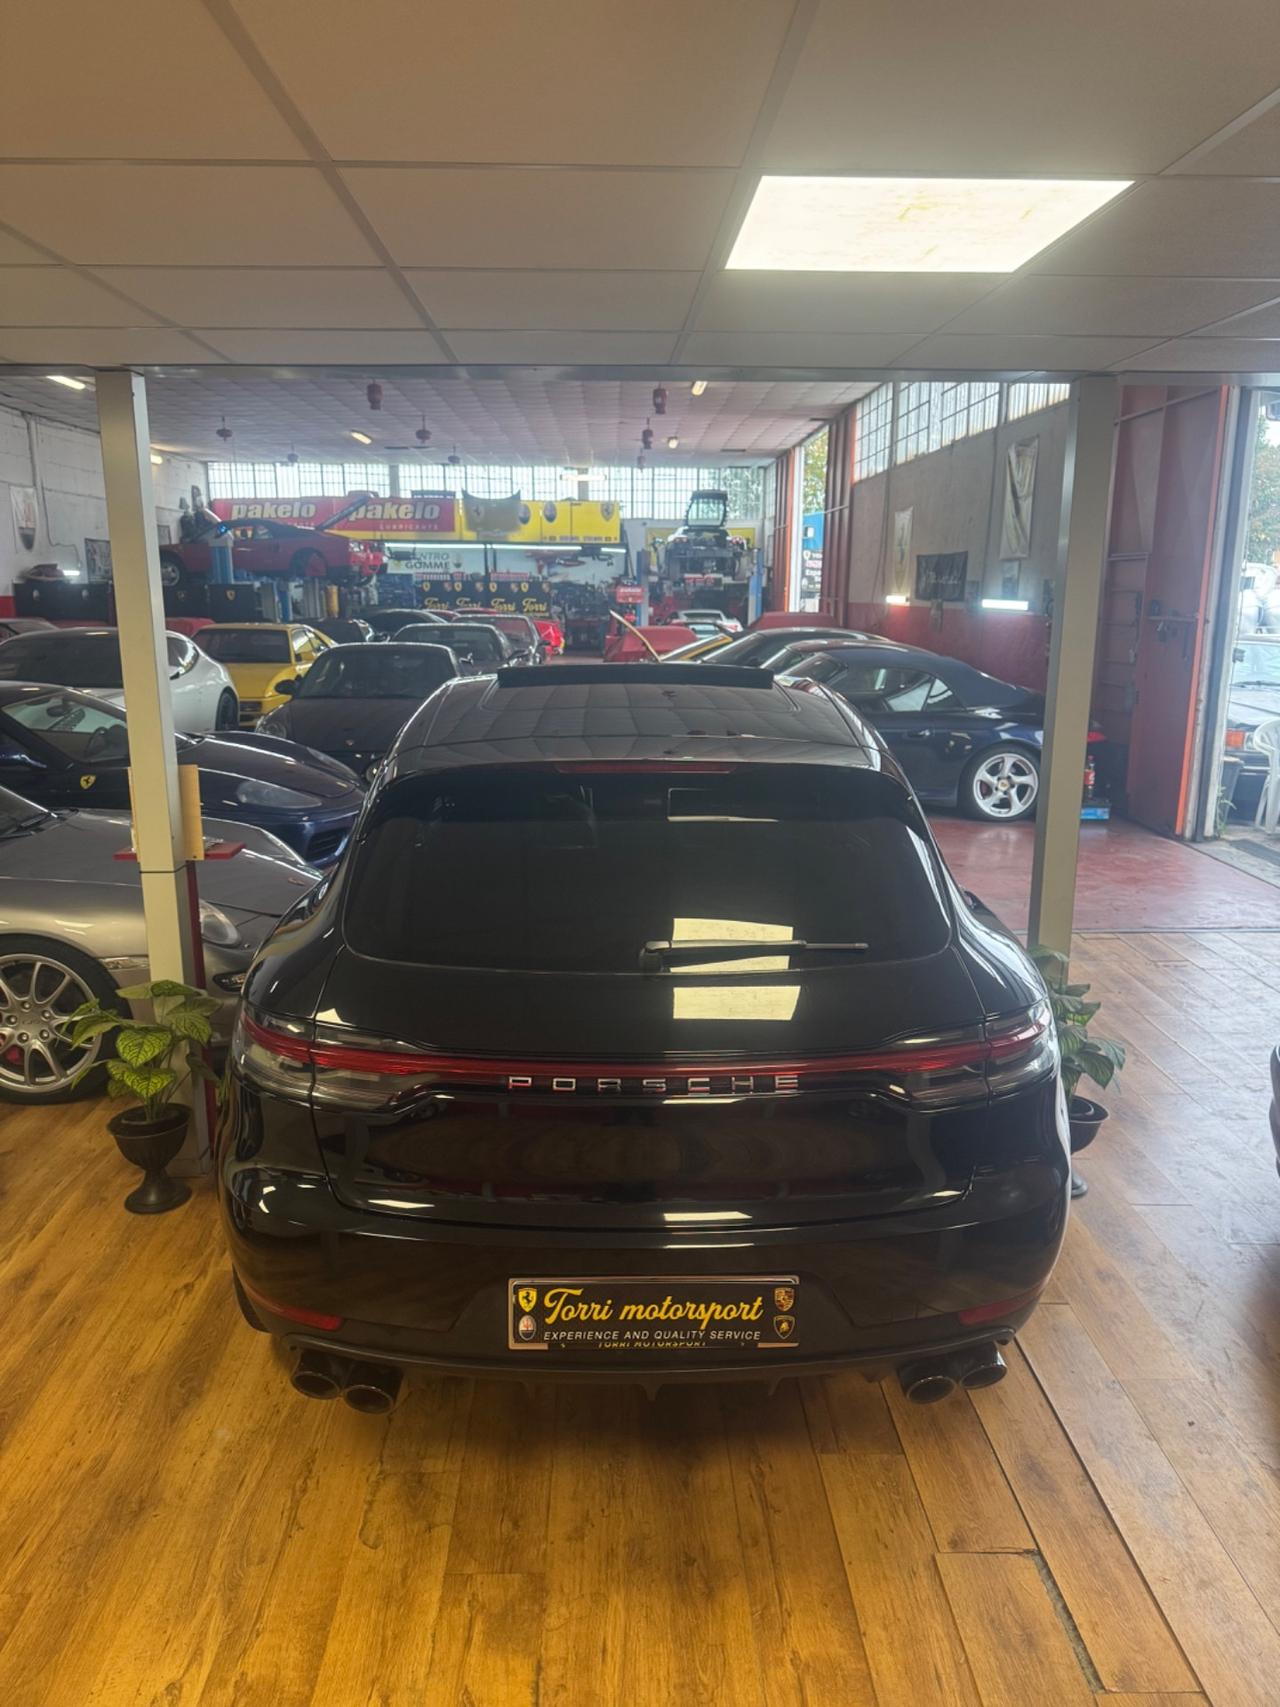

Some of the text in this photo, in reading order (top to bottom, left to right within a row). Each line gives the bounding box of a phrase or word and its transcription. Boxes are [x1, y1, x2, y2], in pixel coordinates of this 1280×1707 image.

[231, 501, 316, 520] pakelo
[349, 501, 440, 521] pakelo
[405, 561, 449, 569] GOMME
[508, 1074, 799, 1092] PORSCHE
[543, 1287, 764, 1331] Torri motorsport
[543, 1330, 761, 1341] EXPERIENCE AND QUALITY SERVICE
